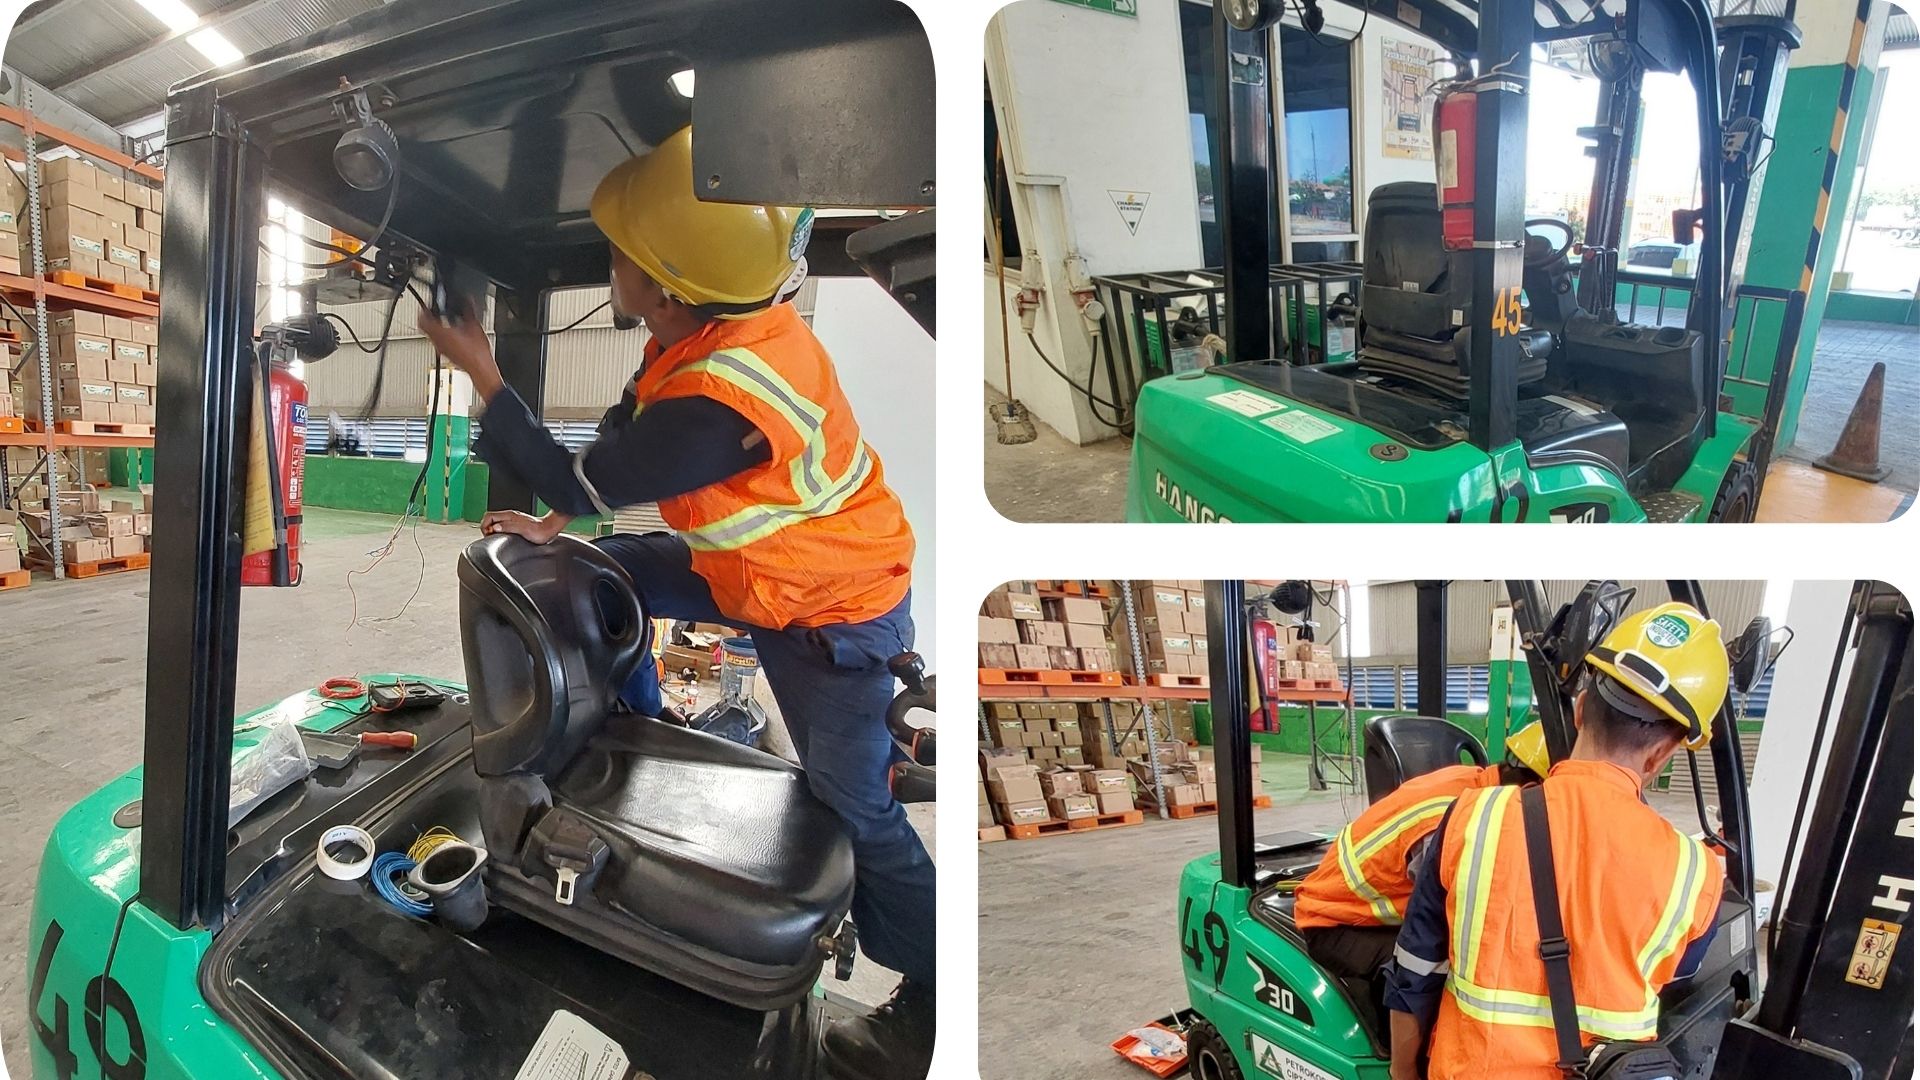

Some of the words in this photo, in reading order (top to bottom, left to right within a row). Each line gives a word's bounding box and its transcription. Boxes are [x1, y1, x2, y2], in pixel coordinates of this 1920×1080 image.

[1492, 286, 1522, 337] 45
[1156, 471, 1232, 523] HANG
[1649, 625, 1678, 645] INDUCTED
[1655, 617, 1686, 637] SAFETY
[731, 656, 755, 665] JOTUN
[1181, 896, 1230, 988] 49
[29, 918, 147, 1080] 49
[1267, 982, 1294, 1015] 30
[1287, 1069, 1306, 1080] CIPT
